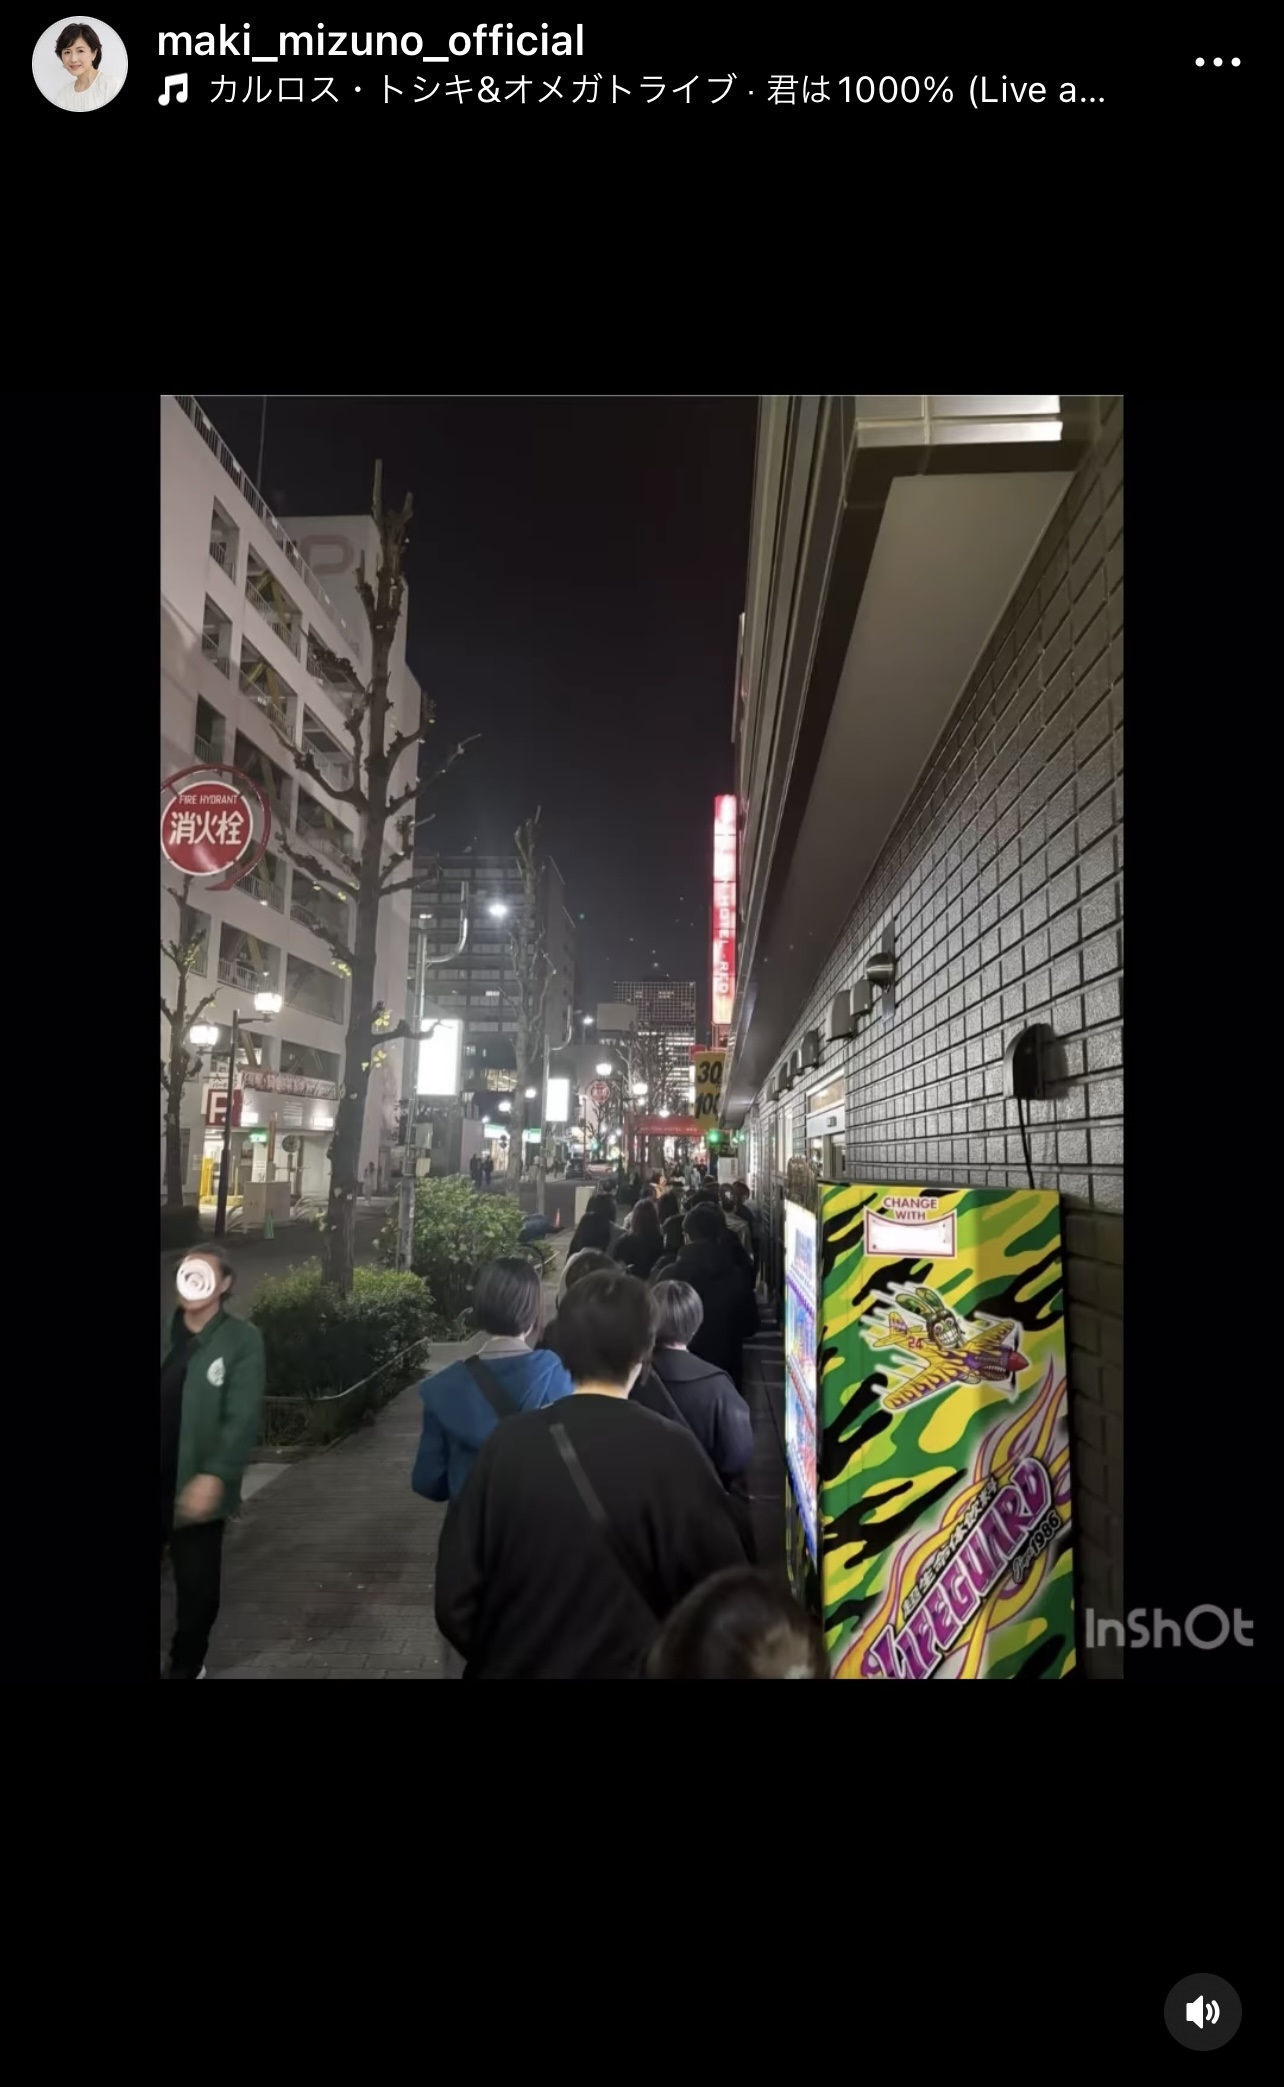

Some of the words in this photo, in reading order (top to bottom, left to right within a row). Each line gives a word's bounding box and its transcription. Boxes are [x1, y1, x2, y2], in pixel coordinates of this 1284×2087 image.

[178, 794, 198, 805] FIRE
[199, 794, 238, 805] HYDRANT
[169, 810, 245, 846] 消火栓
[883, 1196, 938, 1209] CHANGE
[895, 1210, 926, 1221] WITH
[907, 1335, 924, 1350] 24
[1030, 1511, 1062, 1556] 1986
[861, 1457, 1052, 1679] LIFEGUARD
